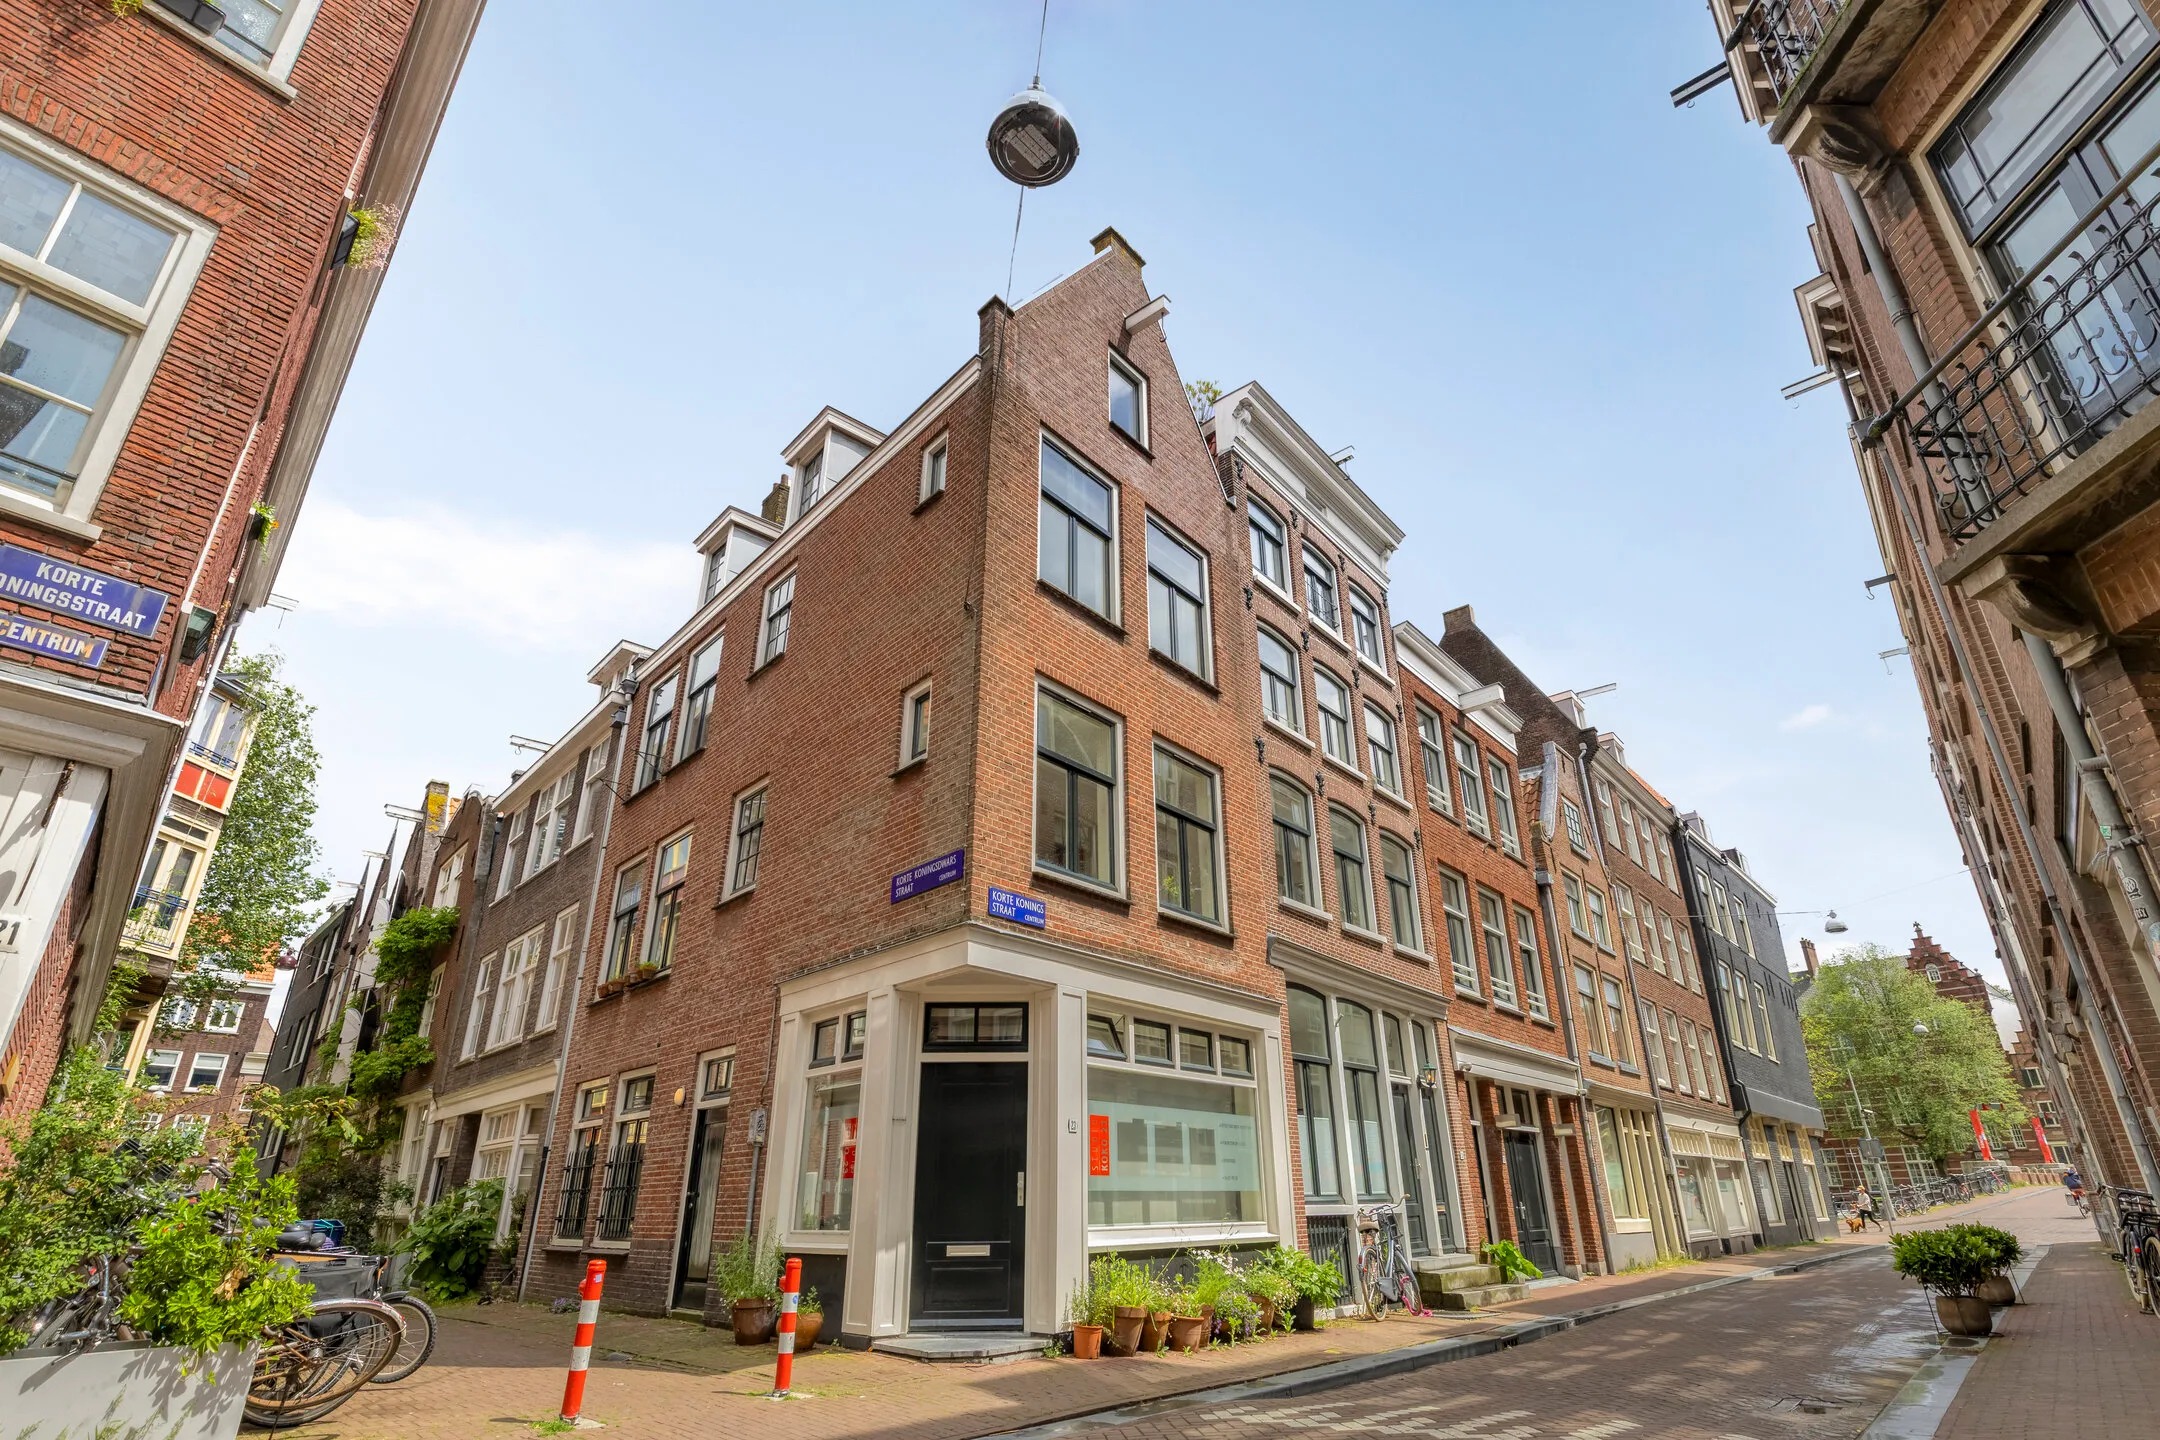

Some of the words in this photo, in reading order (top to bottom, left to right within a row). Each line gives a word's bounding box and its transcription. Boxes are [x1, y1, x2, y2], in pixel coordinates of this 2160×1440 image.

[36, 562, 107, 596] KORTE
[896, 872, 913, 886] KORTE
[914, 854, 957, 880] KONINGSDWARS
[938, 870, 957, 881] CENTRUM
[895, 883, 914, 898] STRAAT
[992, 890, 1014, 906] KORTE
[1015, 896, 1044, 914] KONINGS
[992, 902, 1016, 917] STRAAT
[1024, 914, 1045, 925] CENTRUM
[1101, 1139, 1109, 1172] KOKO
